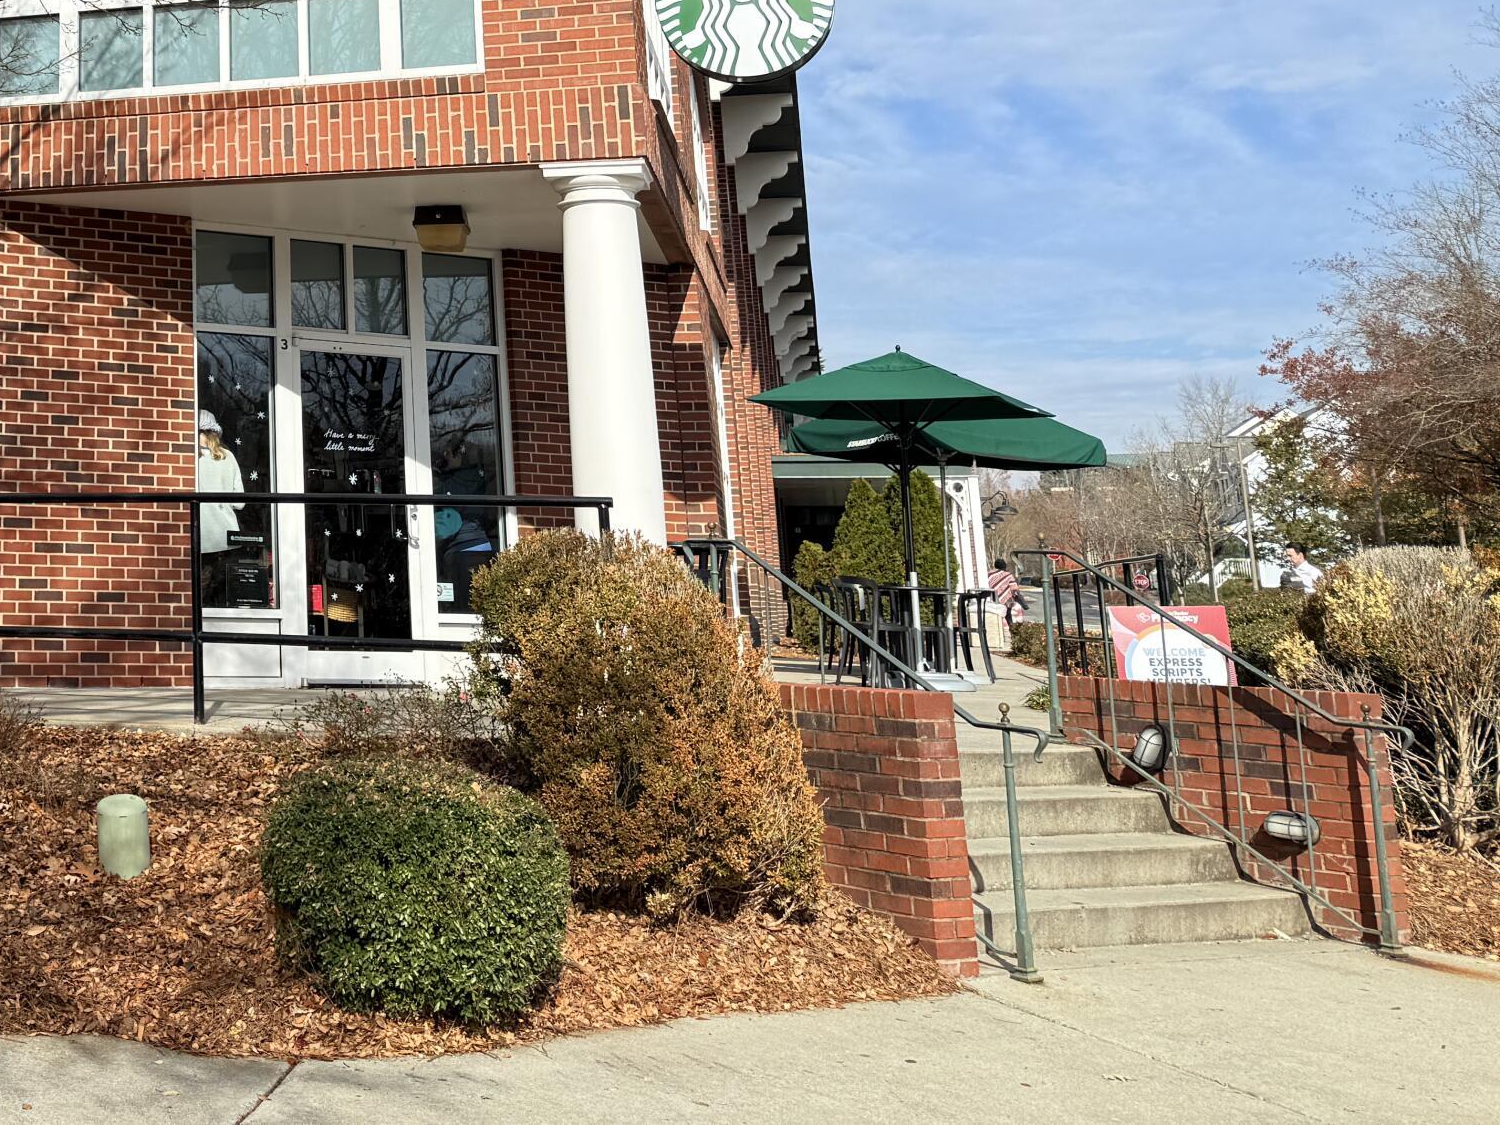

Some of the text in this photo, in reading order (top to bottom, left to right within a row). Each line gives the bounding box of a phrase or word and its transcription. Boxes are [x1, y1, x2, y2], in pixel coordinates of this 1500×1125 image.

[280, 338, 288, 350] 3
[324, 428, 345, 438] Have
[356, 434, 380, 446] merry
[323, 439, 376, 452] little moment
[1149, 658, 1203, 666] EXPRESS
[1152, 668, 1203, 676] SCRIPTS
